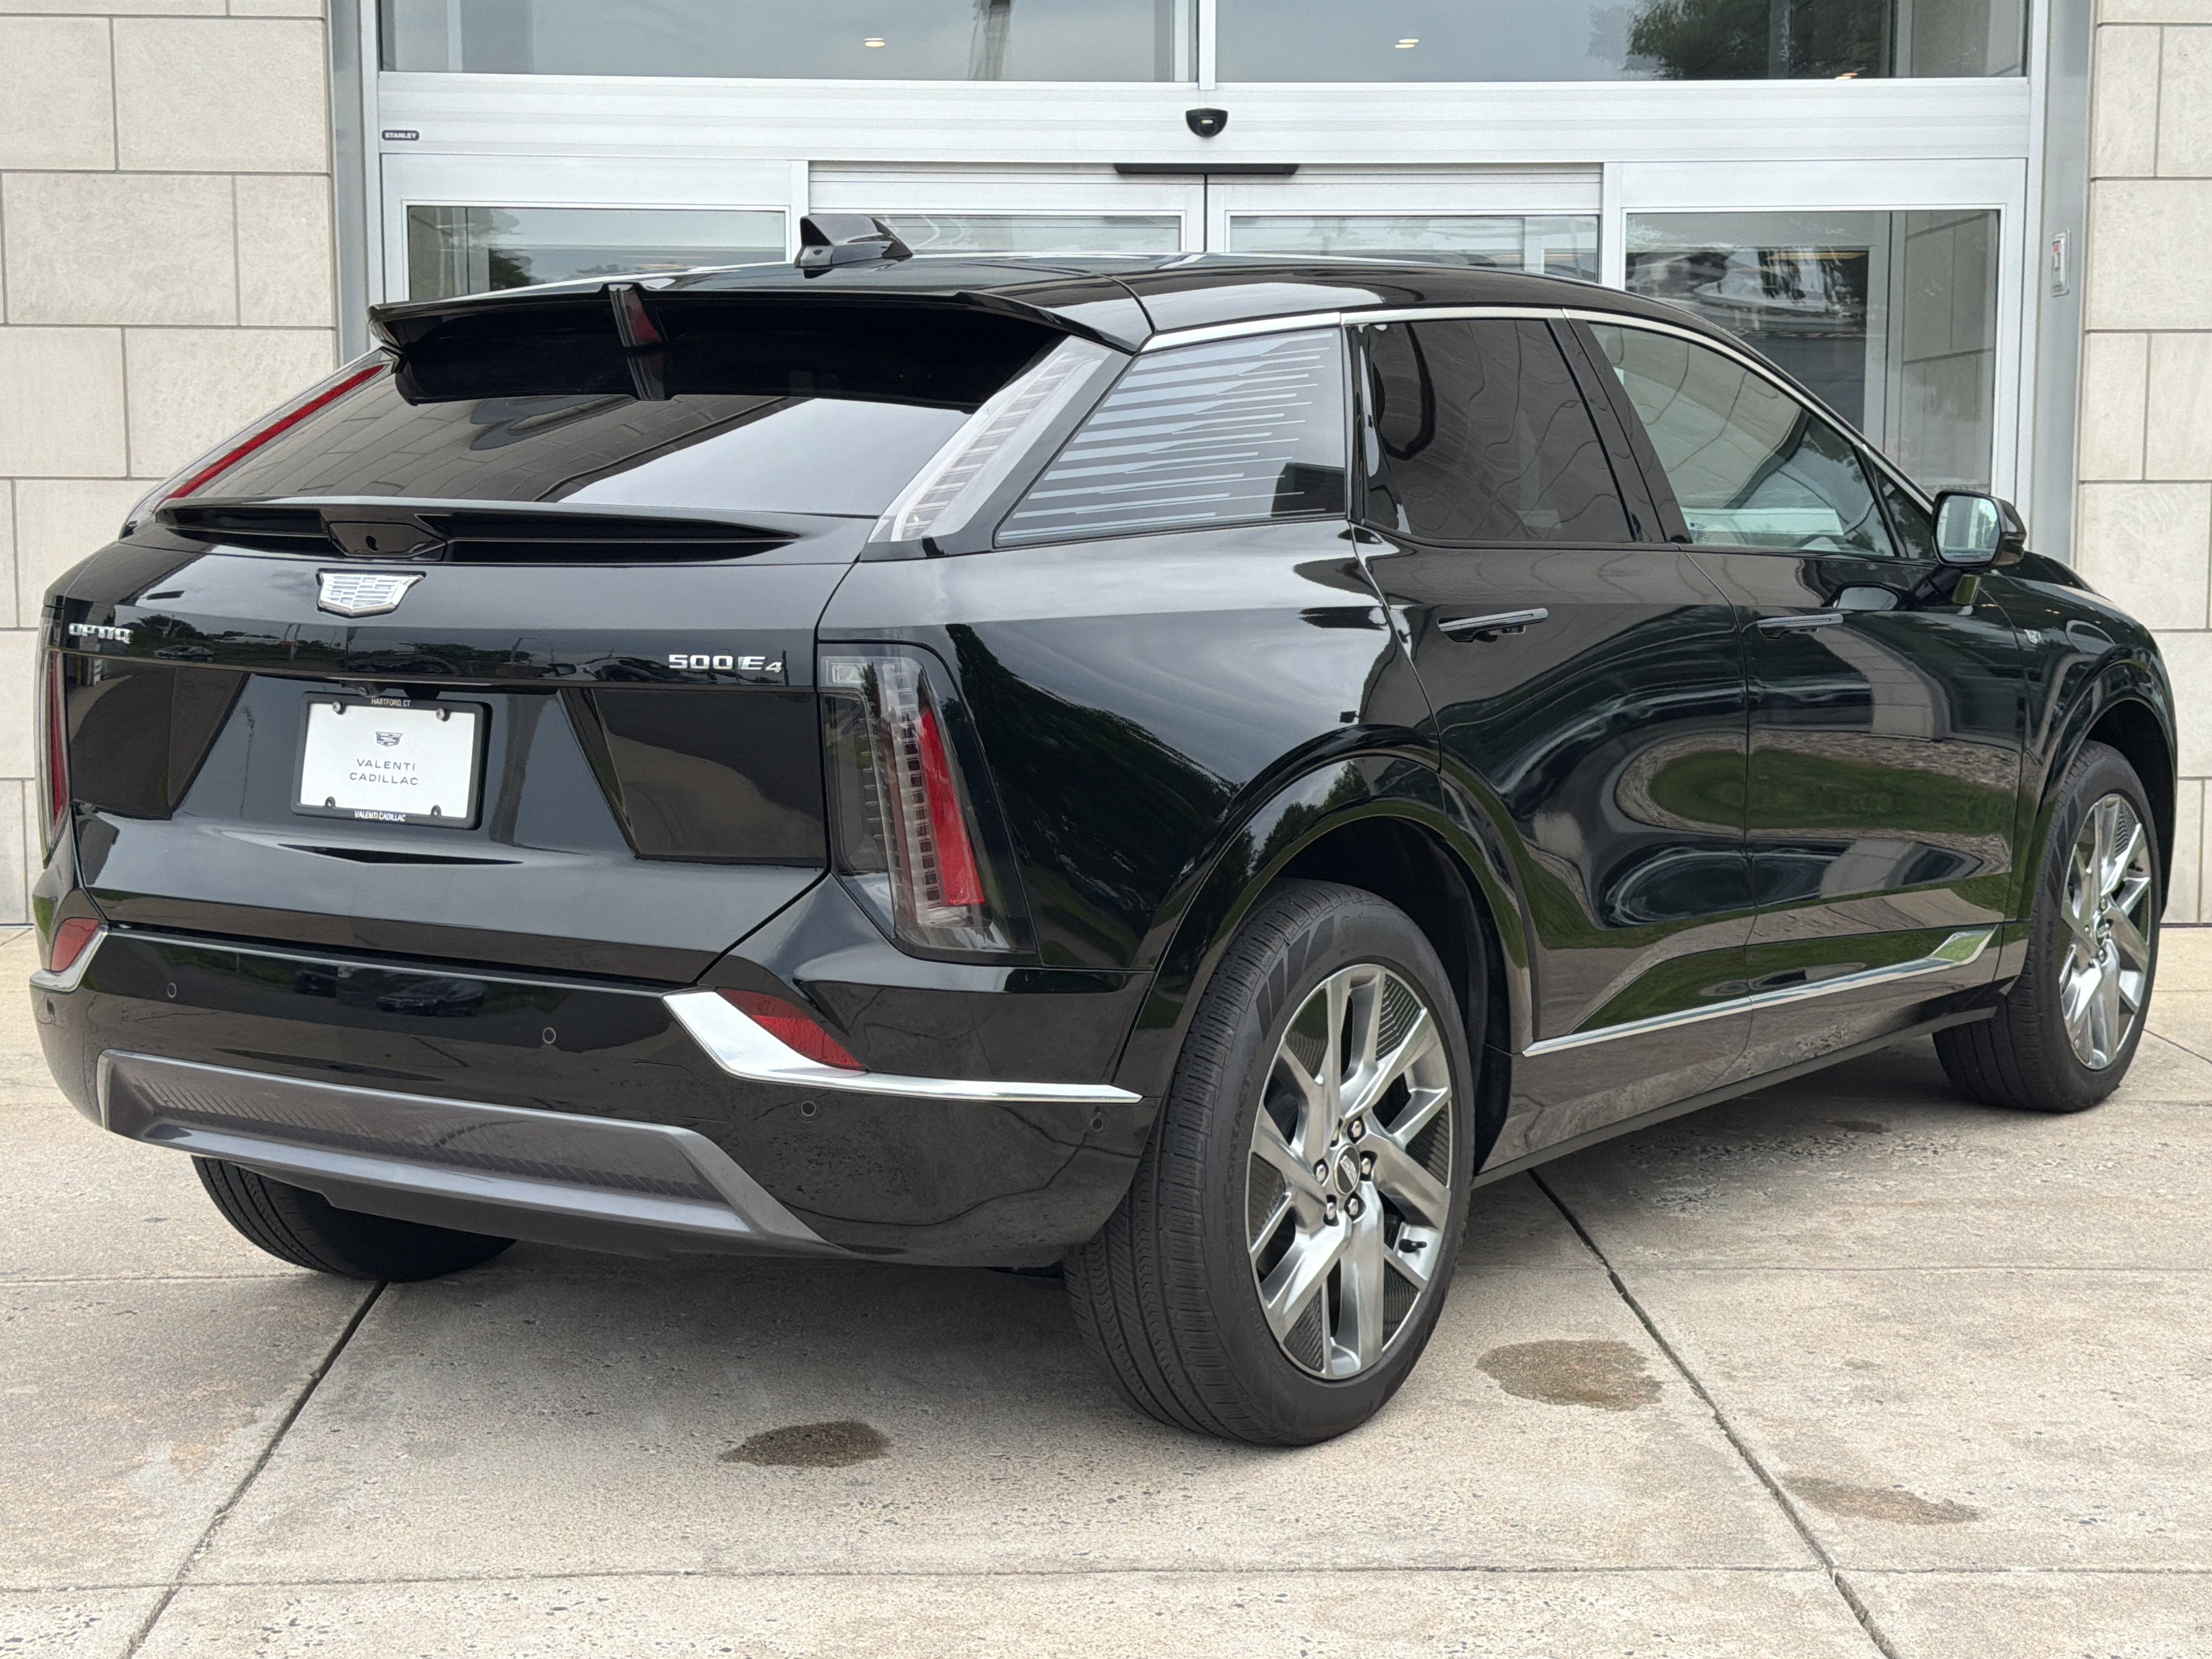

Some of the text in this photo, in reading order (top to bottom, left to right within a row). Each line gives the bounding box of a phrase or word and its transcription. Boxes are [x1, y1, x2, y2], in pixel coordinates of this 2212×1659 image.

[371, 698, 403, 707] HARTFORD,
[357, 759, 415, 771] VALENTI
[349, 772, 419, 786] CADILLAC
[354, 810, 406, 822] VALENTI CADILLAC
